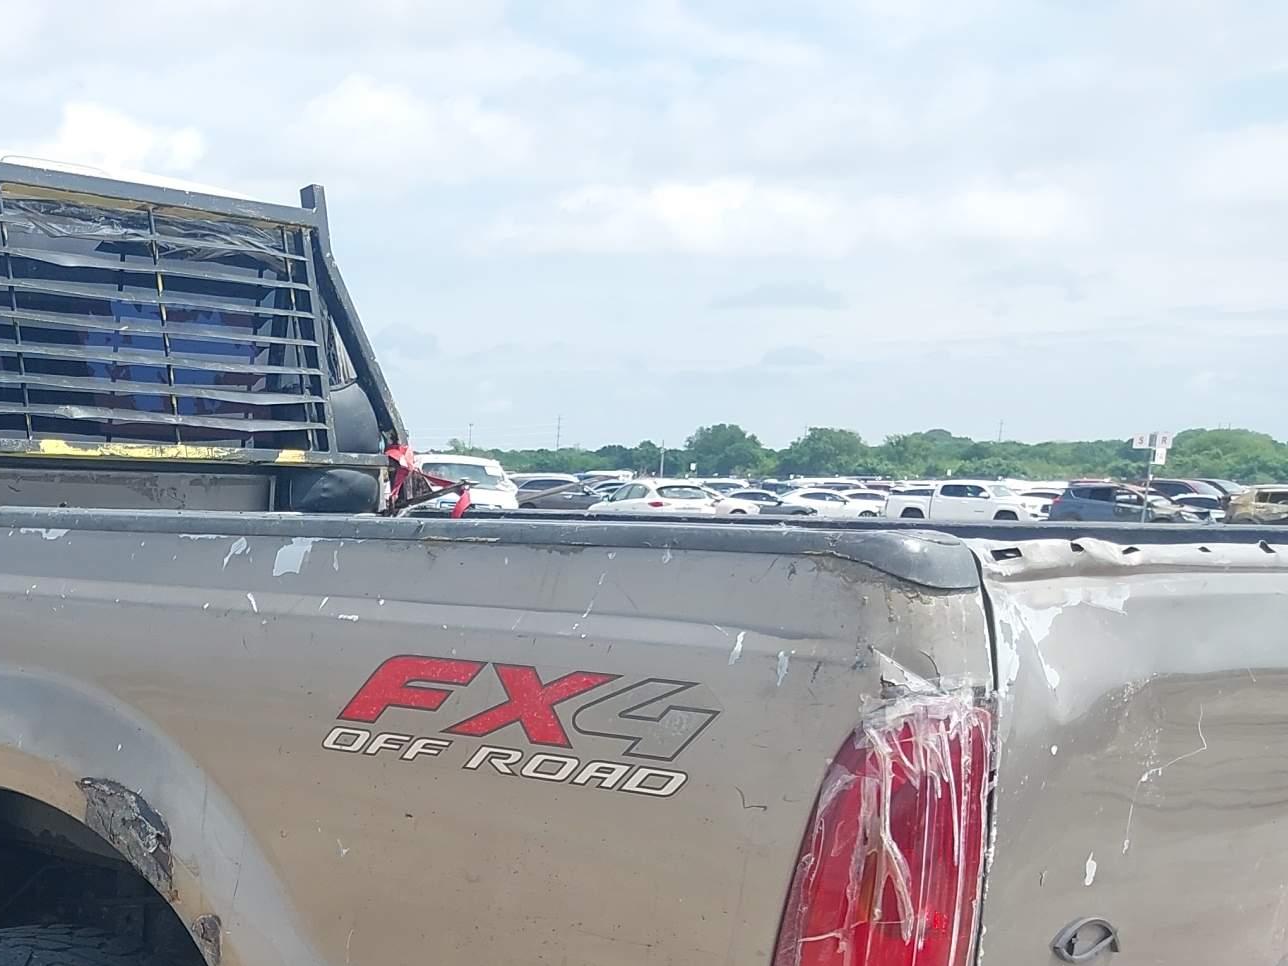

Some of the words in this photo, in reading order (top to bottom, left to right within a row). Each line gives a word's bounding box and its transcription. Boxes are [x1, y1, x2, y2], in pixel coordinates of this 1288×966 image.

[338, 654, 721, 762] FX4
[321, 725, 453, 761] OFF
[463, 743, 690, 798] ROAD
